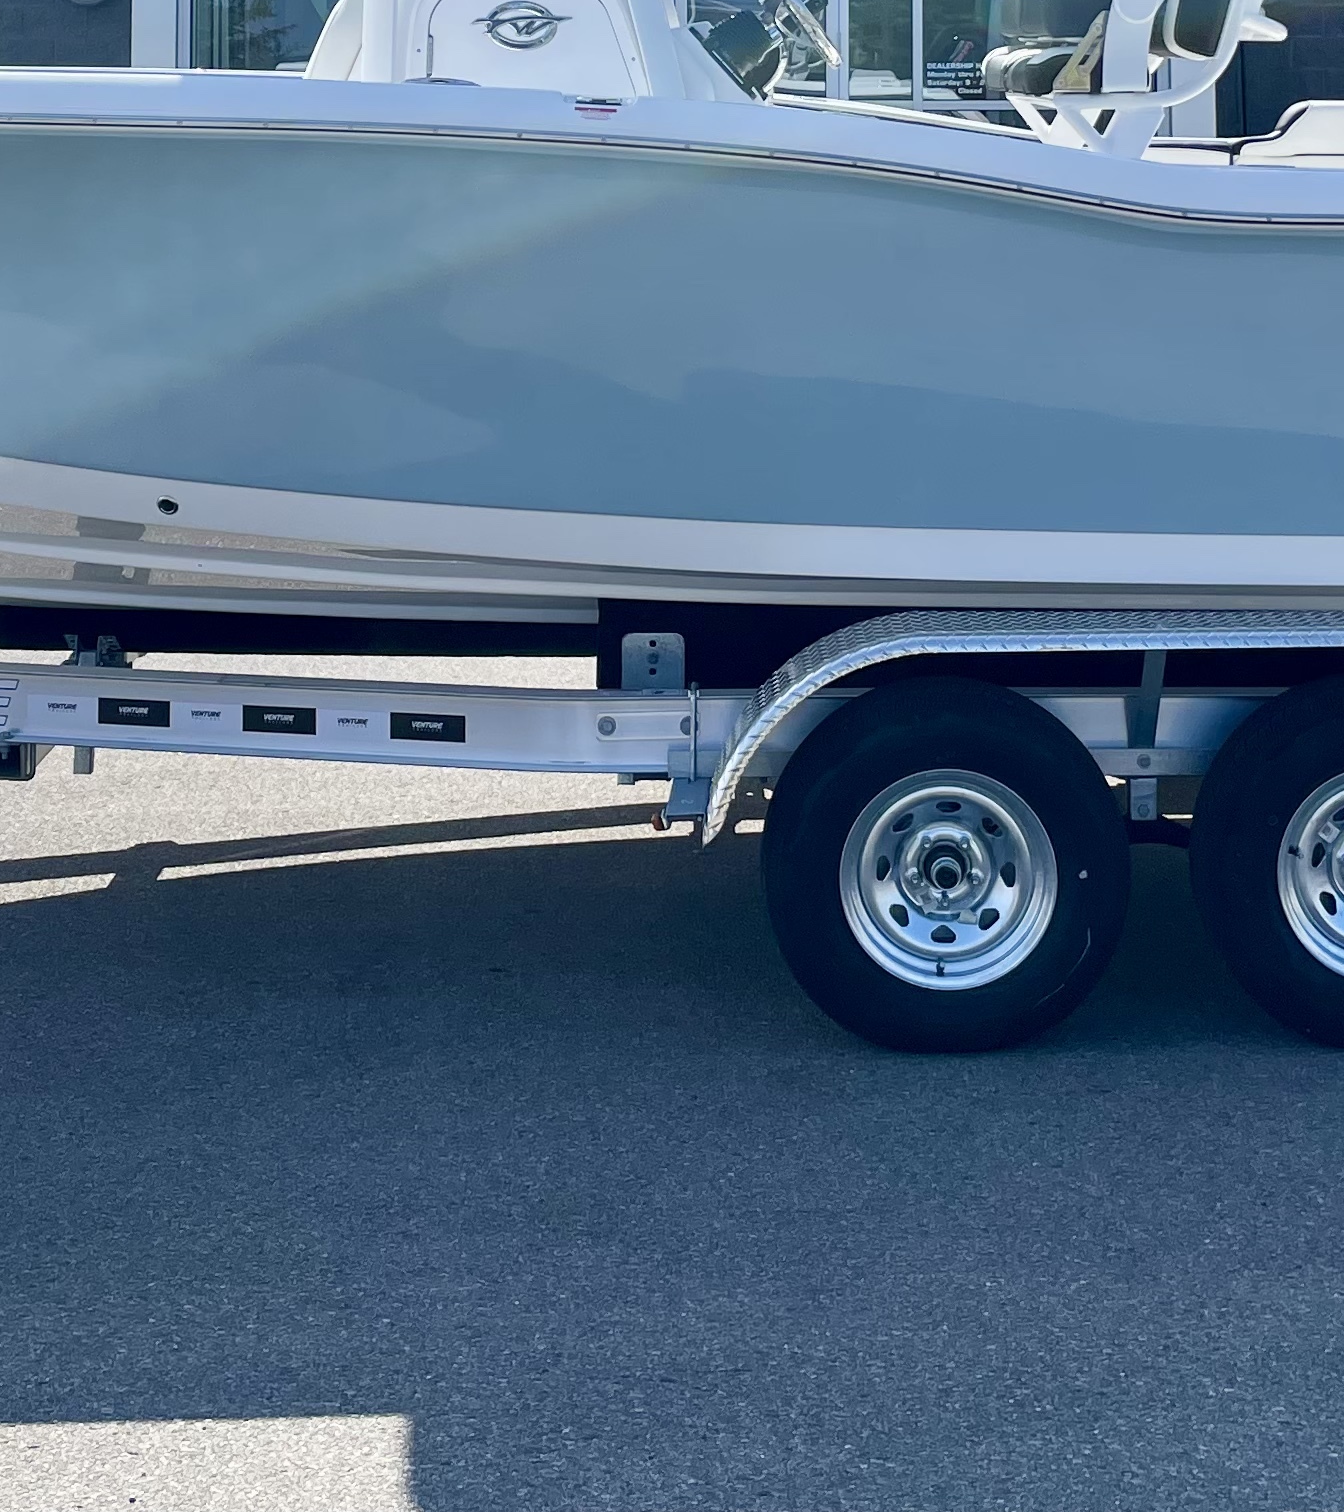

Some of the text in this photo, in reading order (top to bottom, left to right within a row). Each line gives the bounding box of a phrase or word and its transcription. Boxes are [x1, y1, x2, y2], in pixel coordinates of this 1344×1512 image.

[47, 702, 78, 710] VENTURE
[118, 706, 149, 714] VENTURE
[190, 710, 222, 718] VENTURE
[263, 713, 295, 722] VENTURE
[337, 717, 369, 726] VENTURE
[411, 720, 444, 729] VENTURE
